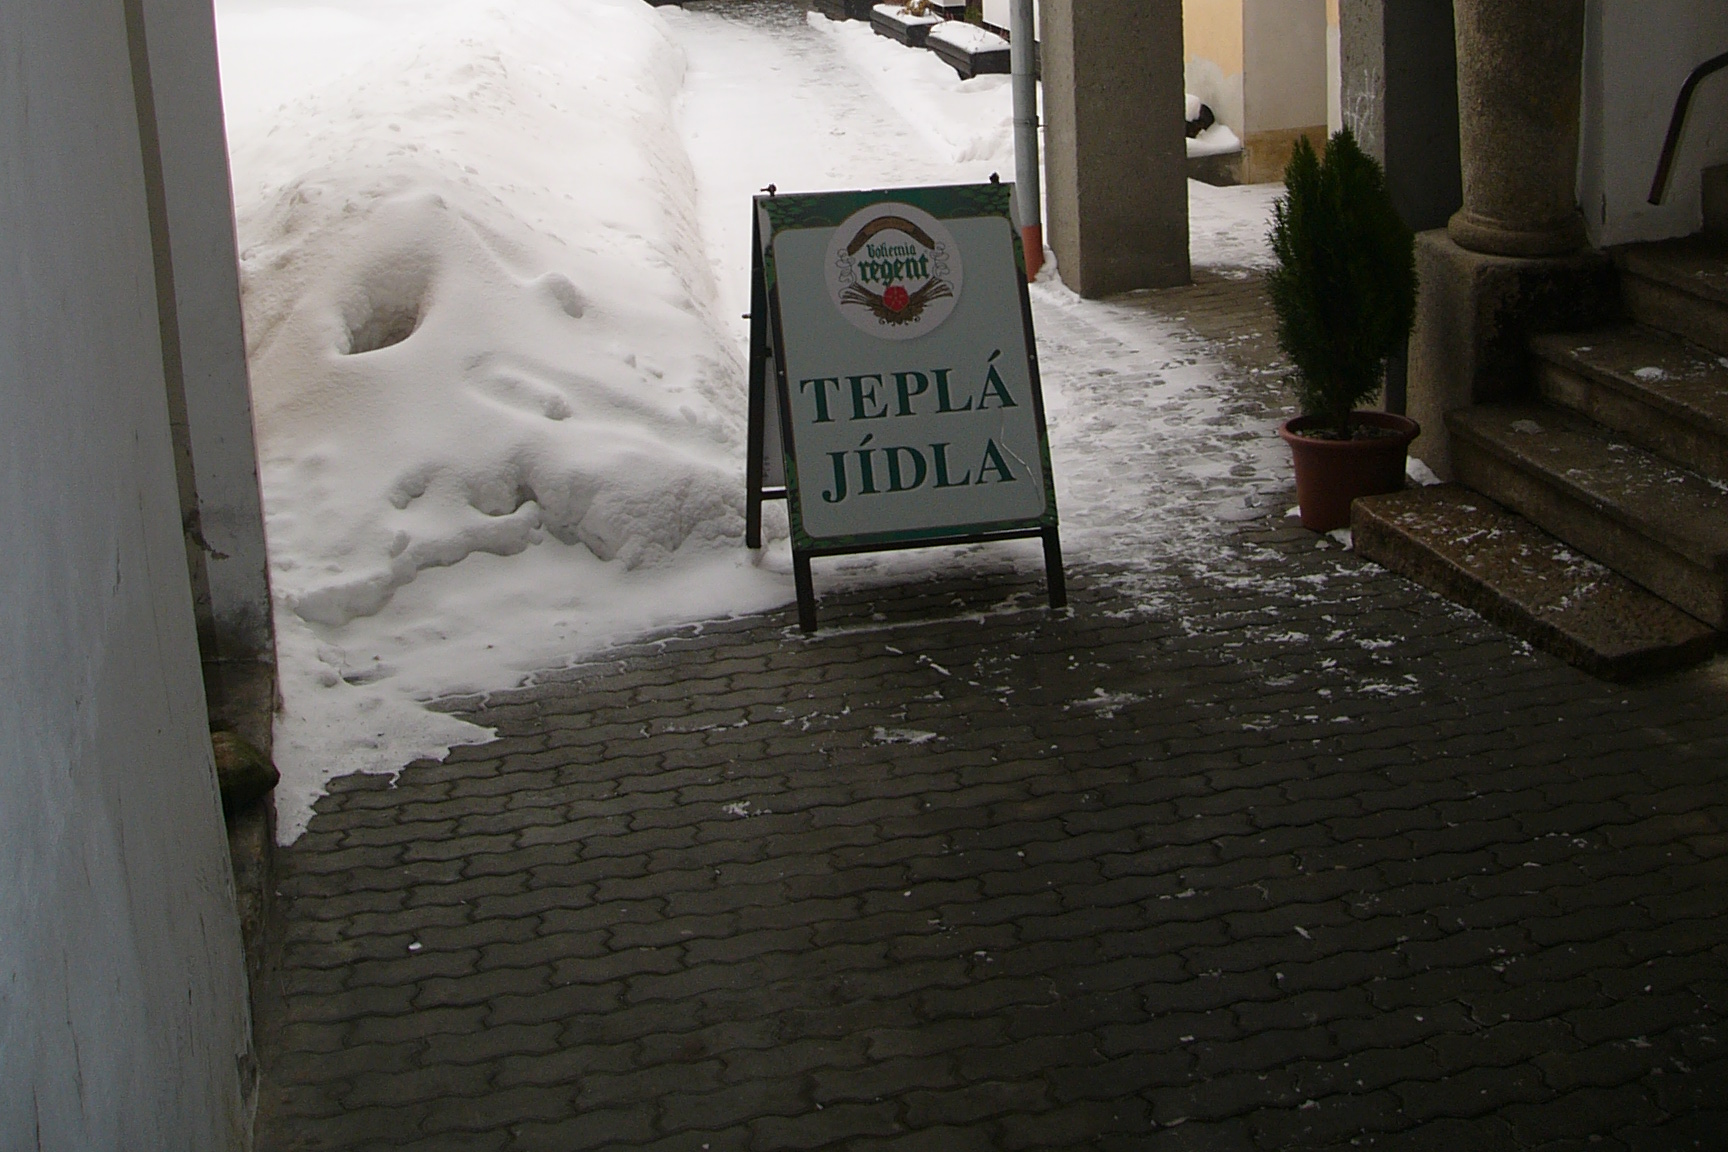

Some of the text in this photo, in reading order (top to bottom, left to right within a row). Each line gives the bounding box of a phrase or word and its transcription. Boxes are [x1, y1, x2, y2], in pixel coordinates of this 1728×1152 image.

[857, 254, 930, 286] regent
[800, 350, 1018, 423] TEPLÁ
[822, 434, 1017, 503] JÍDLA
